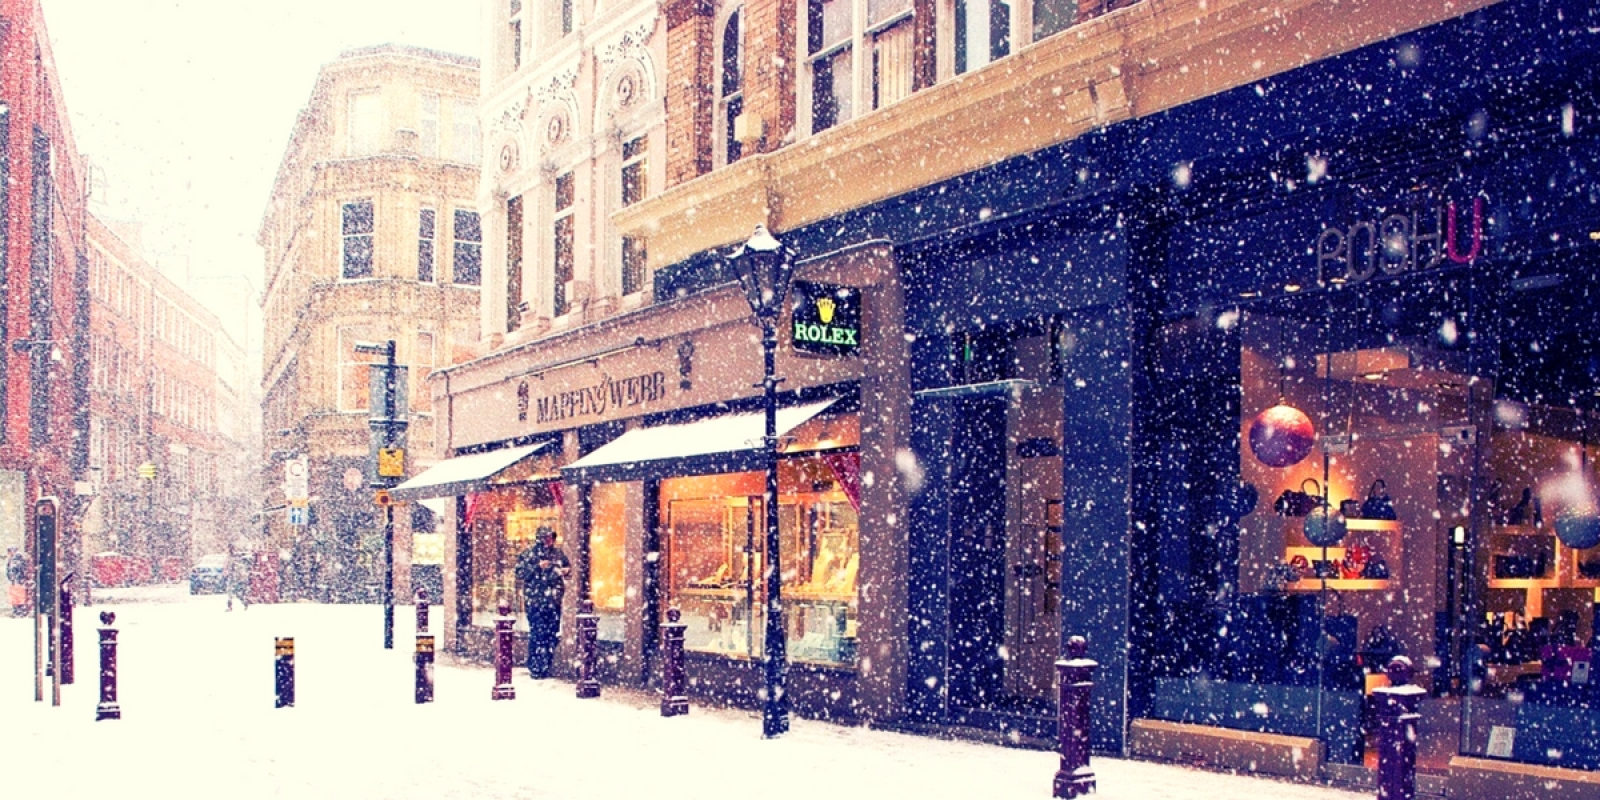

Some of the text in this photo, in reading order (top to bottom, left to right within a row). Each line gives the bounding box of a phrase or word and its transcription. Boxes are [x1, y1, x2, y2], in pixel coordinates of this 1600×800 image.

[795, 323, 858, 345] ROLEX
[536, 384, 599, 424] MAPPIN
[609, 371, 666, 409] WEBB
